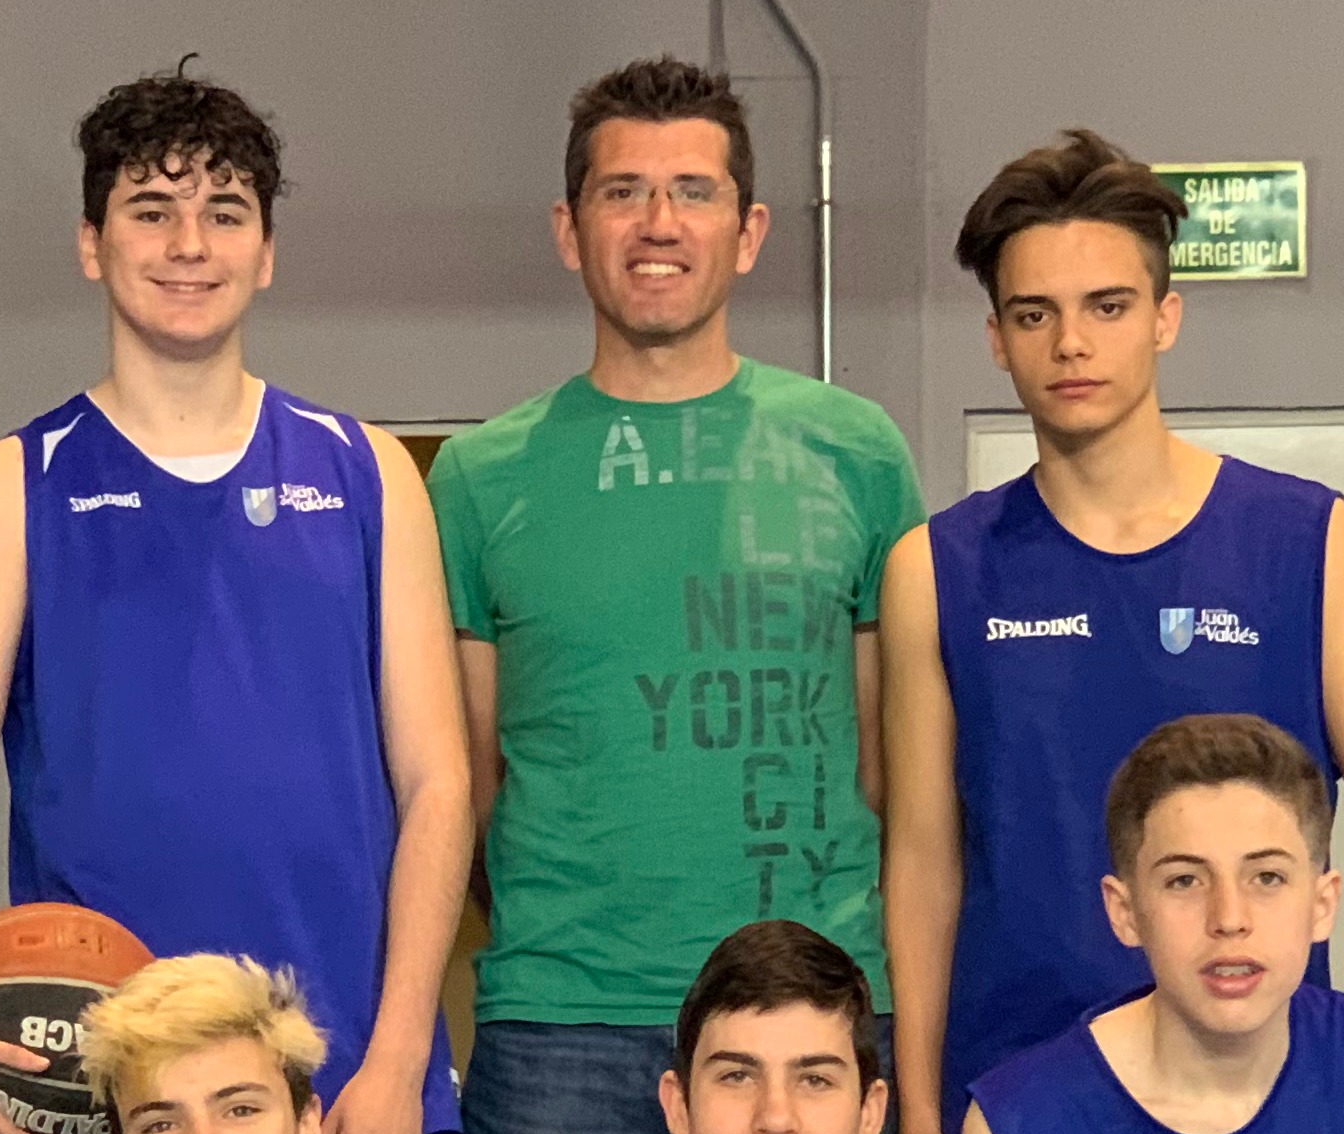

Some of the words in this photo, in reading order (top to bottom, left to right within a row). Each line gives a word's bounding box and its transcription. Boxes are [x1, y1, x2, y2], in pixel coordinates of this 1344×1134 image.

[1184, 177, 1261, 203] SALIDA
[1208, 209, 1237, 235] DE
[1168, 240, 1293, 268] MERGENCIA
[683, 571, 840, 654] NEW
[1195, 608, 1239, 626] Juan
[986, 613, 1092, 642] SPALDING
[1205, 625, 1260, 645] Valdés
[633, 667, 830, 752] YORK
[742, 752, 827, 832] CI
[742, 839, 842, 917] TY
